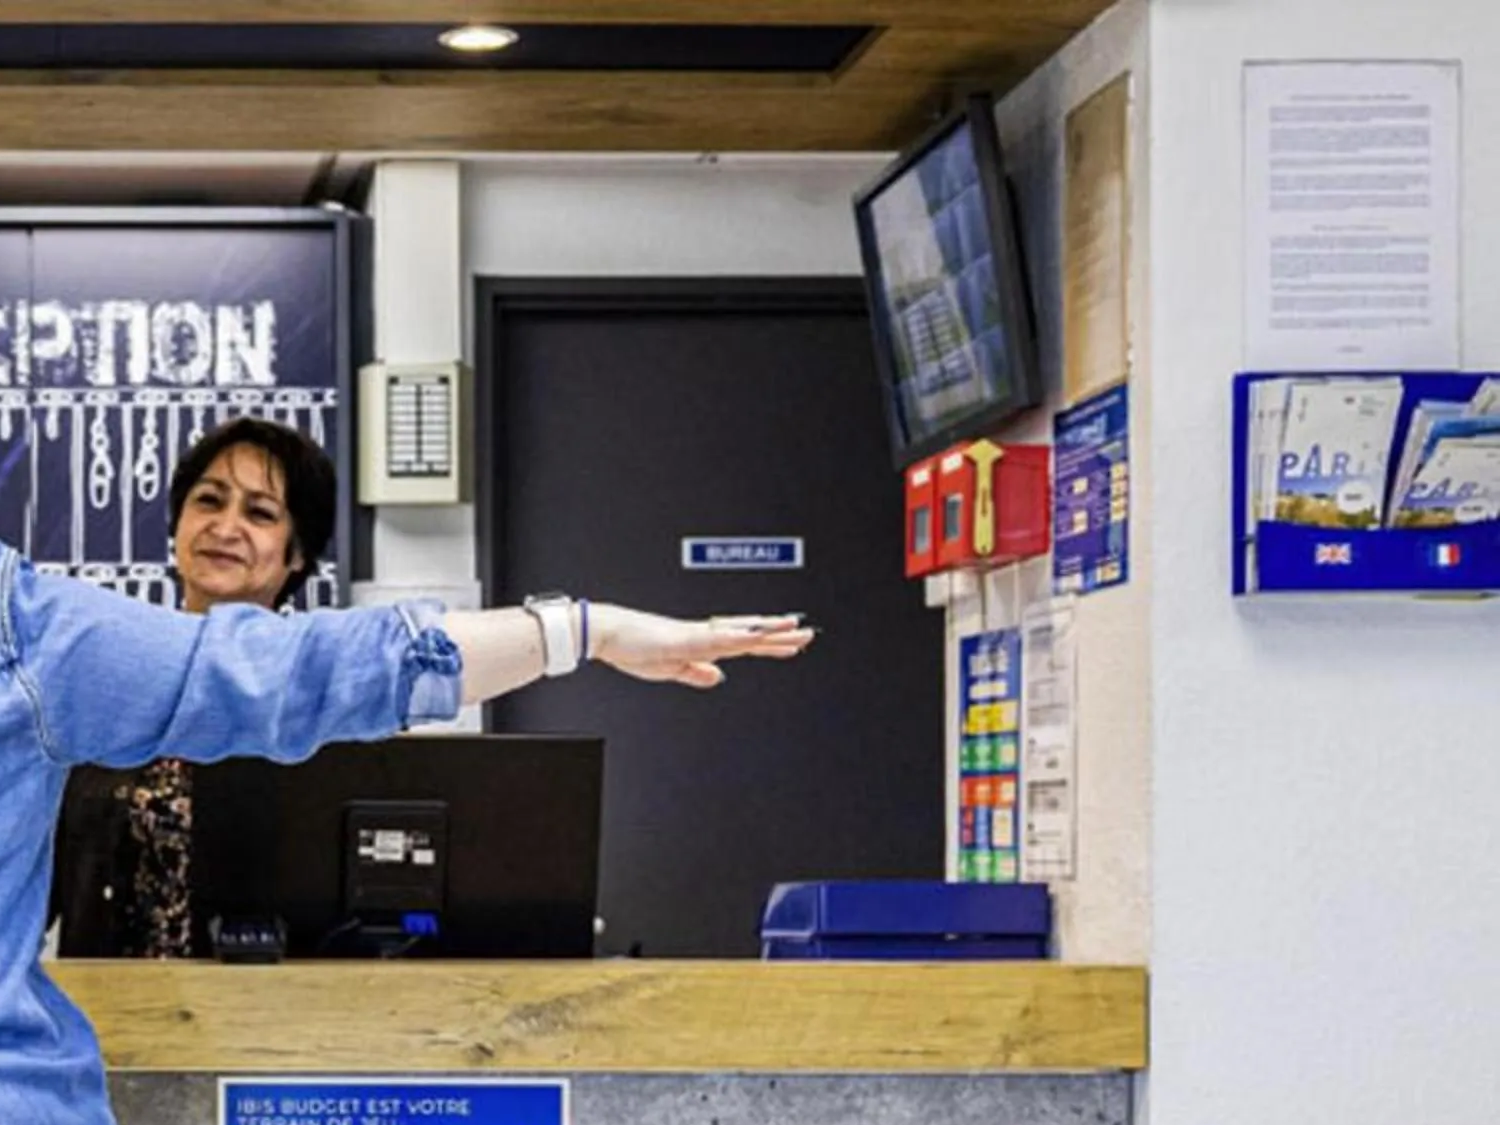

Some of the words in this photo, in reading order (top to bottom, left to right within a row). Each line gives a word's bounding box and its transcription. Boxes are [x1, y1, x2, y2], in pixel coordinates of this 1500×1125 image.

[706, 546, 780, 561] BUREAU
[237, 1098, 276, 1115] IBIS
[280, 1098, 360, 1115] BUDGET
[367, 1098, 401, 1115] EST
[407, 1098, 471, 1115] VOTRE
